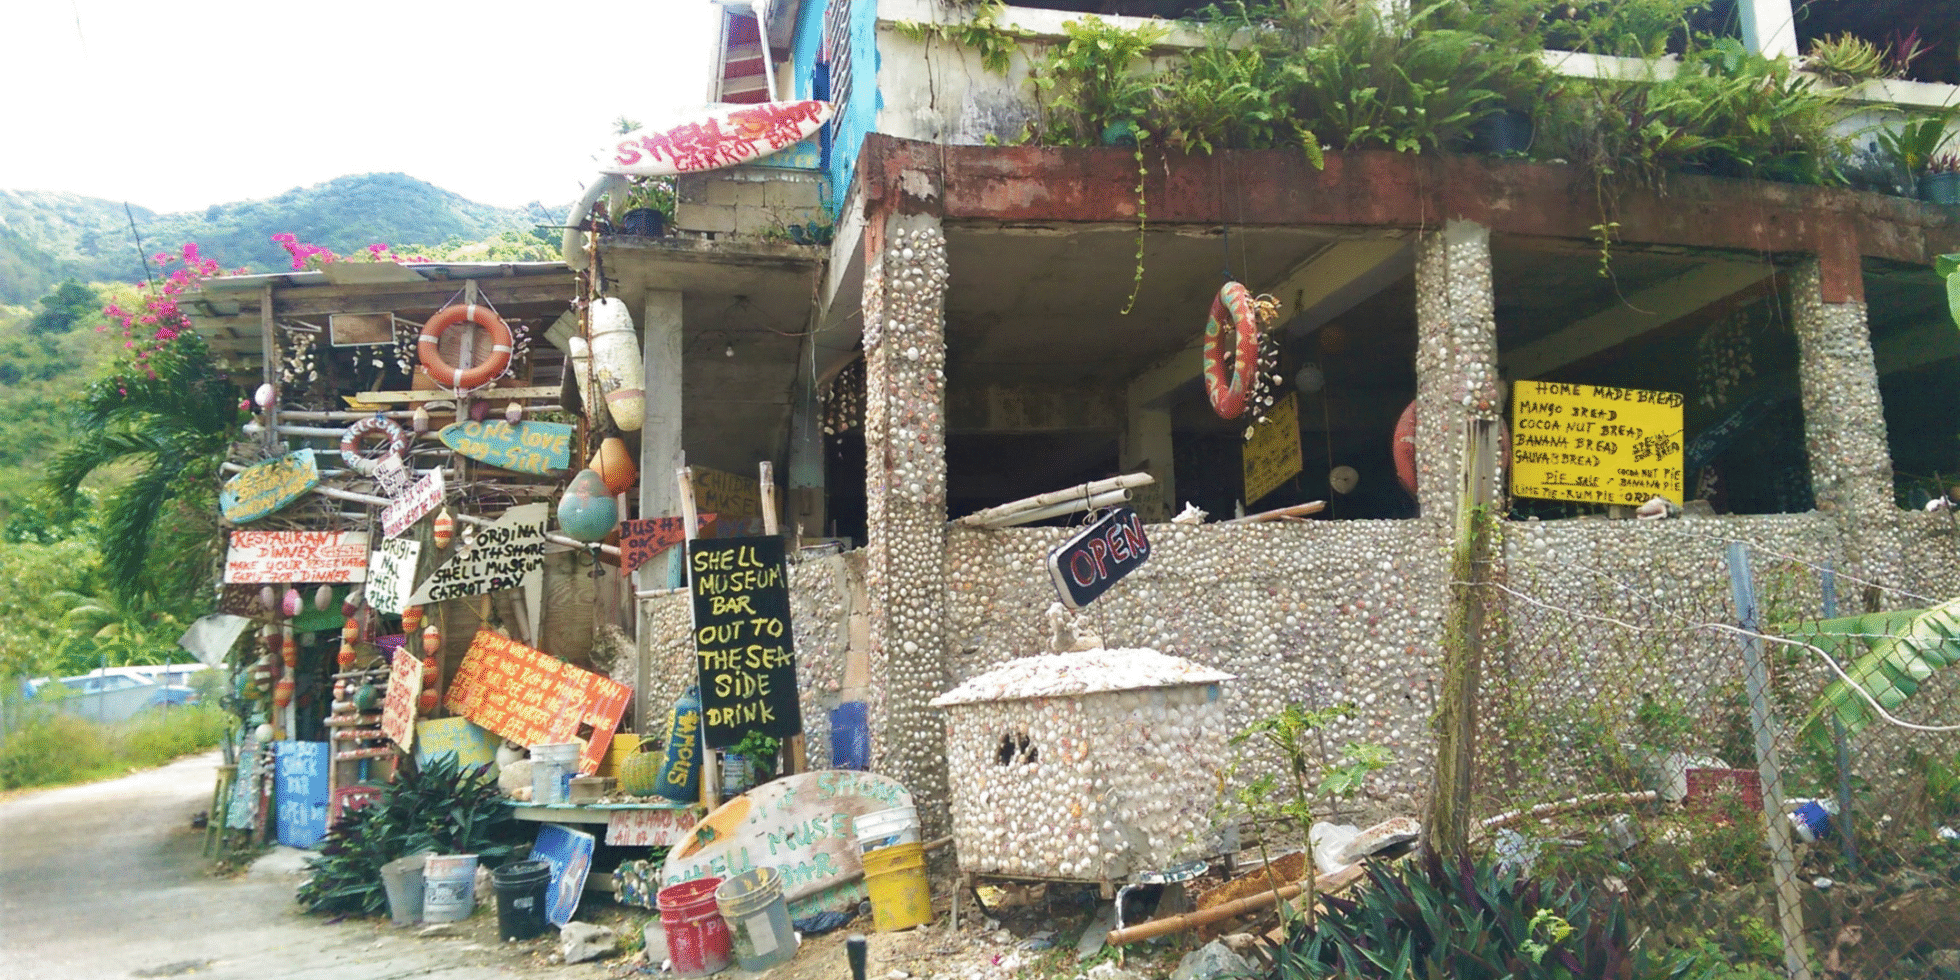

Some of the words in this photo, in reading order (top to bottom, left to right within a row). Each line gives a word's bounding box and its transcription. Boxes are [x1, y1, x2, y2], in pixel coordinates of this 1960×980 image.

[674, 138, 761, 171] CARROT
[769, 117, 803, 150] BAY
[1536, 382, 1581, 396] HOME
[1593, 386, 1633, 401] MADE
[1637, 389, 1683, 408] BREAD
[1572, 406, 1617, 421] BREAD
[465, 419, 515, 442] ONE
[521, 425, 569, 454] LOVE
[1519, 418, 1561, 431] COCOA
[1566, 421, 1595, 433] NUT
[1600, 424, 1643, 440] BREAD
[1515, 433, 1569, 448] BANANA
[1575, 437, 1618, 455] BREAD
[1562, 453, 1600, 467] BREAD
[1641, 468, 1658, 478] NUT
[230, 531, 344, 548] RESTAURANT
[1070, 512, 1147, 587] OPEN
[381, 555, 399, 579] NAL
[432, 565, 480, 583] SHELL
[485, 557, 543, 576] MUSEUM
[694, 545, 764, 572] SHELL
[368, 570, 397, 595] SHELL
[429, 579, 485, 600] CARROT
[487, 573, 524, 593] BAY
[699, 563, 785, 596] MUSEUM
[710, 595, 756, 615] BAR
[699, 620, 744, 645] OUT
[750, 617, 784, 638] TO
[698, 647, 743, 670] THE
[745, 644, 794, 669] SEA
